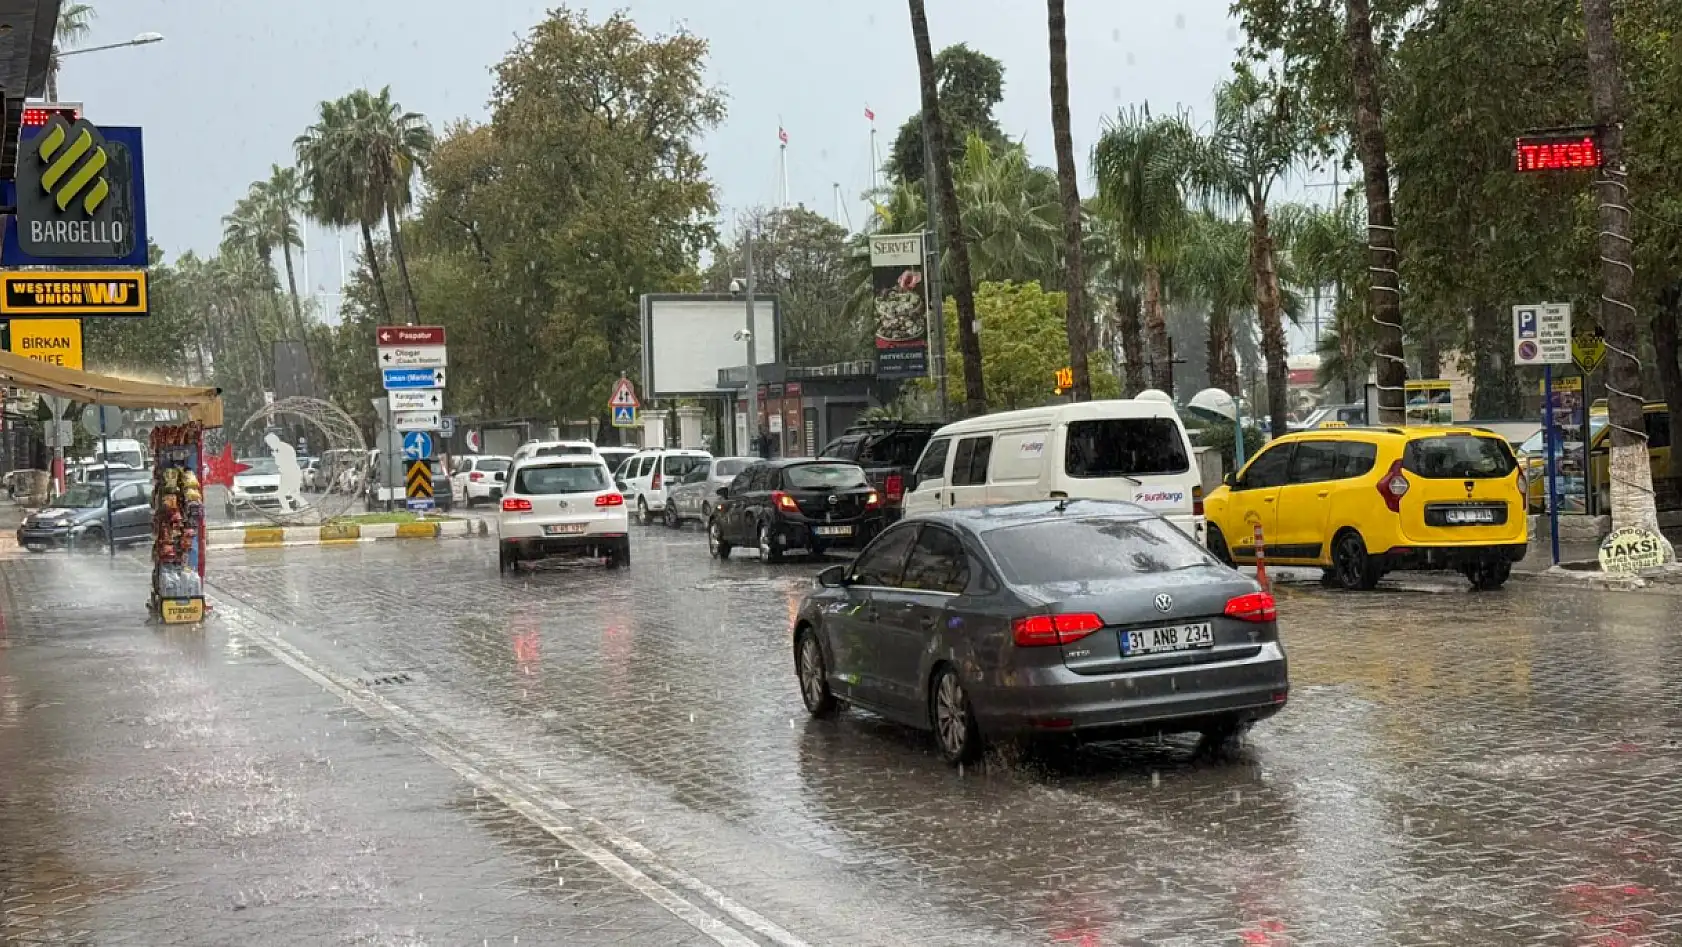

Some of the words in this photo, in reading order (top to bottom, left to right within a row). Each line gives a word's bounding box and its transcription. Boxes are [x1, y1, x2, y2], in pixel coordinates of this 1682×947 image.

[31, 220, 123, 243] BARGELLO
[874, 240, 916, 254] SERVET
[13, 283, 81, 294] WESTERN
[88, 283, 129, 304] WU
[35, 293, 82, 304] UNION
[22, 333, 70, 349] BİRKAN
[399, 331, 432, 342] Paspatur
[395, 349, 420, 359] Otogar
[880, 351, 922, 361] servet.com
[385, 374, 406, 382] Liman
[1130, 631, 1145, 649] 31
[1154, 628, 1179, 647] ANB
[1185, 624, 1210, 643] 234
